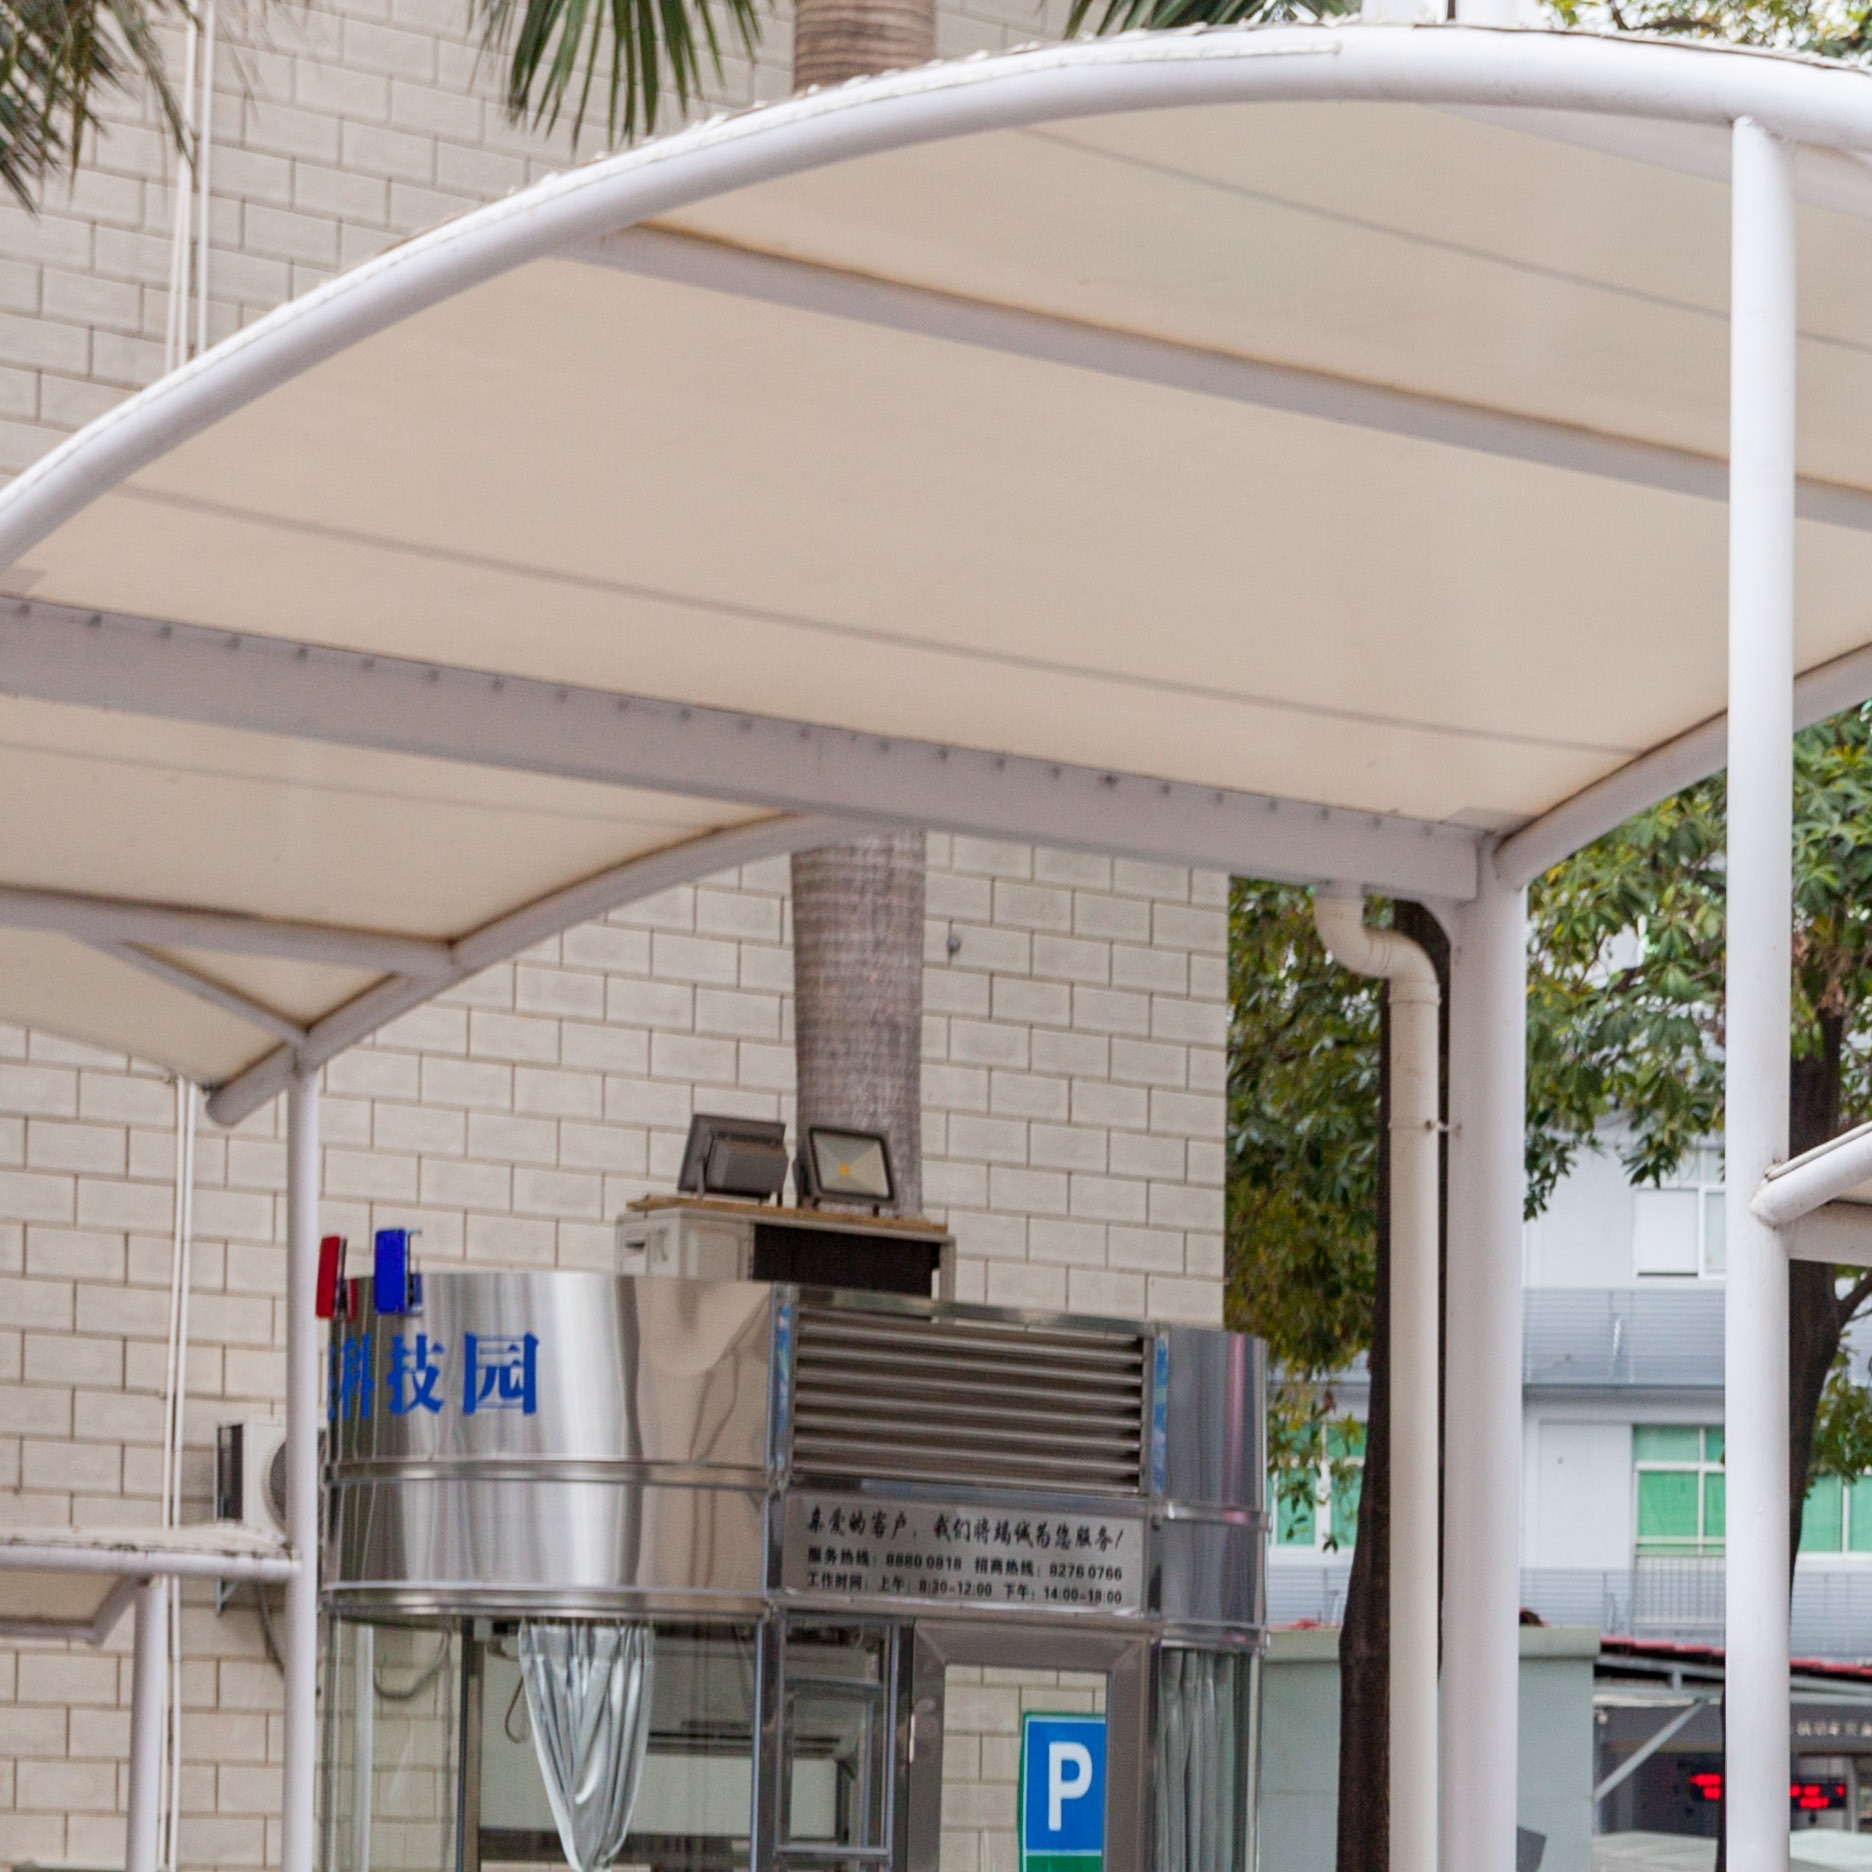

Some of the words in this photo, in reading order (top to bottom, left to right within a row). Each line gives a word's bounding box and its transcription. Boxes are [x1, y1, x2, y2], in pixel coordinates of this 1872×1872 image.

[327, 1331, 540, 1421] 科技园
[1048, 1741, 1093, 1832] P
